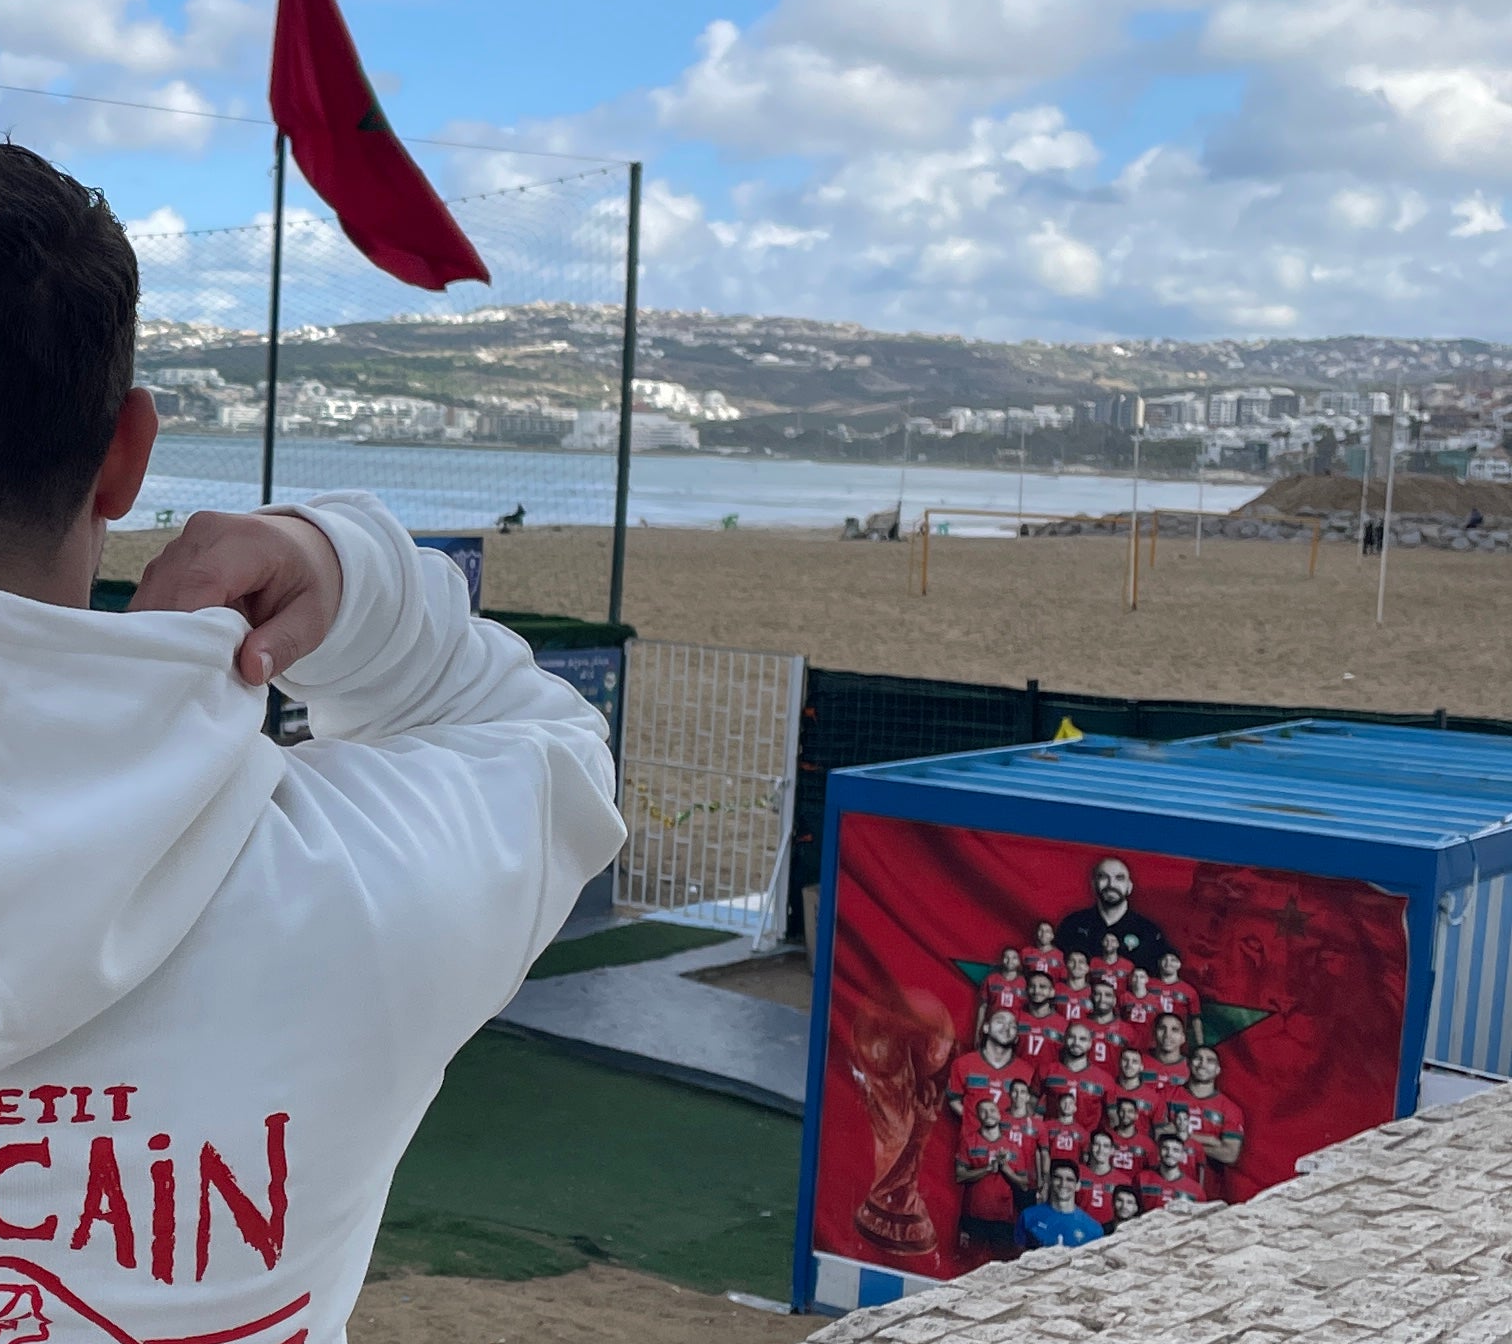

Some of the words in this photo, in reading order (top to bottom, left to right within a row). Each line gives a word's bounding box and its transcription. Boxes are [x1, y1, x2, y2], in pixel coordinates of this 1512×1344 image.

[1028, 1034, 1044, 1055] 17
[1095, 1042, 1106, 1061] 9
[989, 1087, 1002, 1104] 7
[1057, 1135, 1073, 1150] 20
[1092, 1189, 1103, 1207] 5
